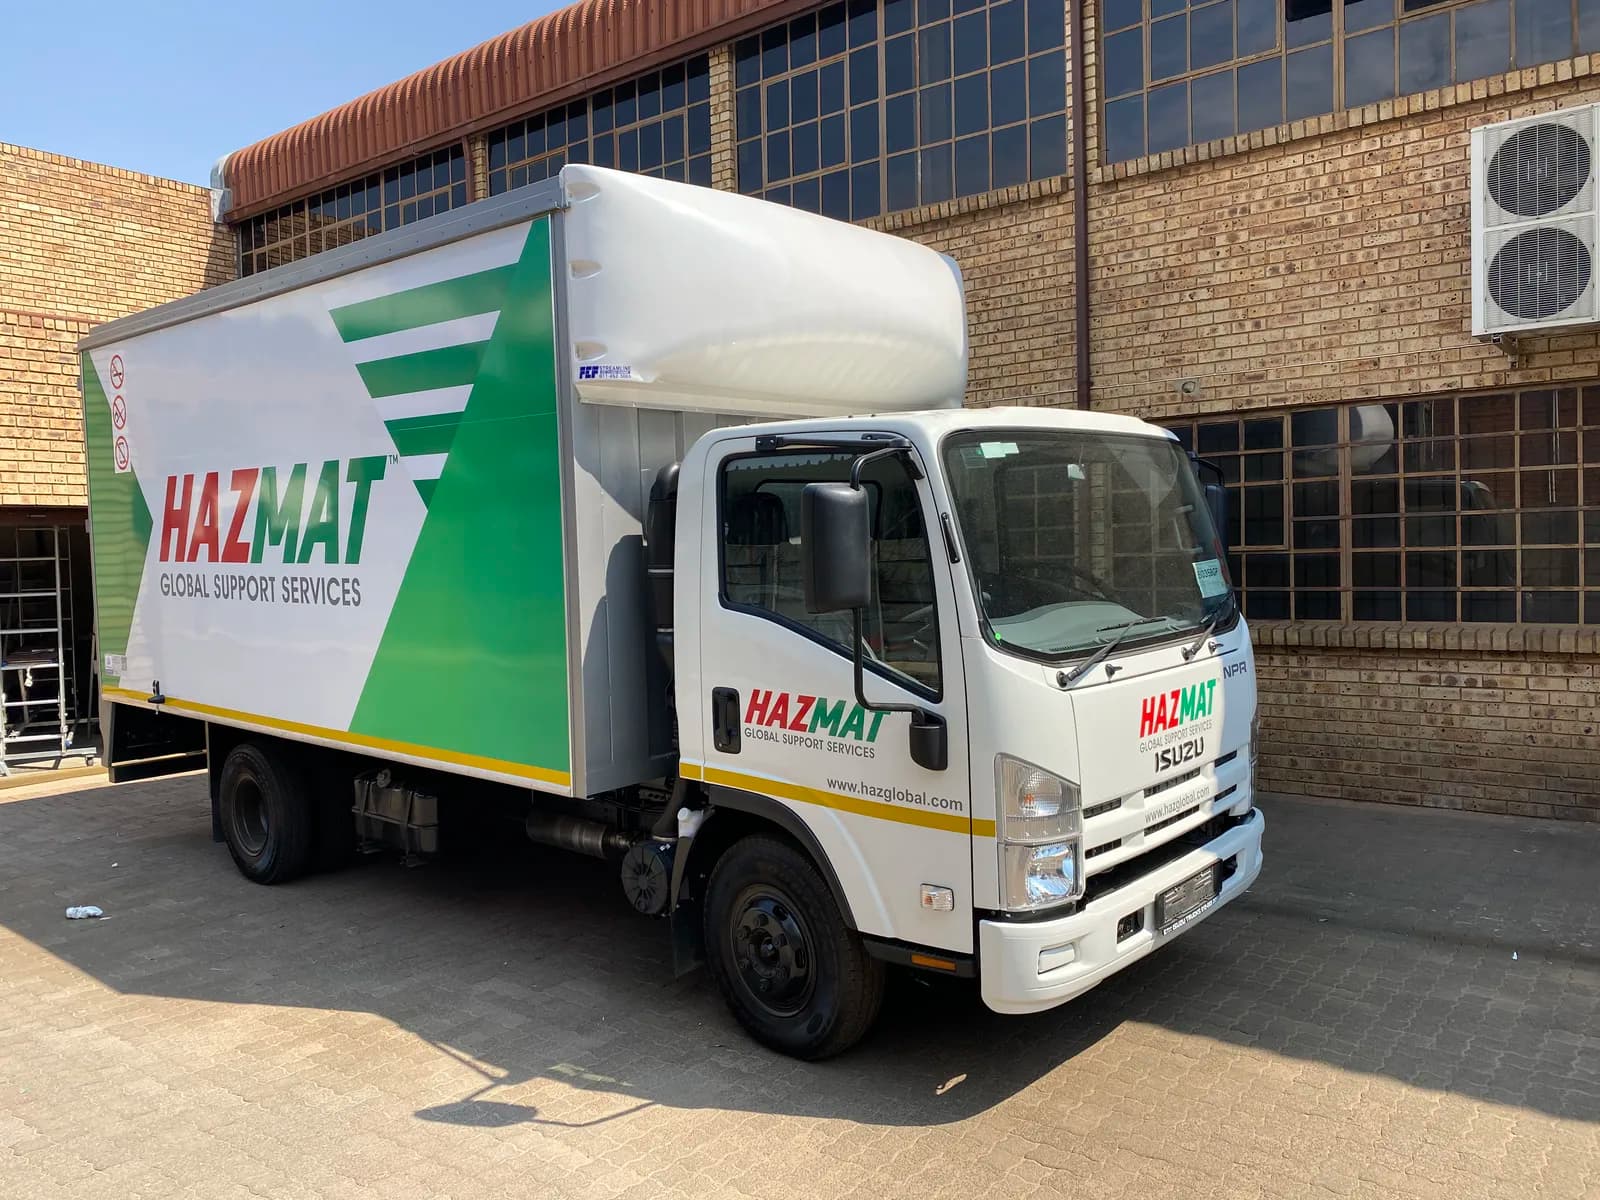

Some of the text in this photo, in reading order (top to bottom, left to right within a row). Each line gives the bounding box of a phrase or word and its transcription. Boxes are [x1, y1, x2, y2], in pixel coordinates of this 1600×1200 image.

[159, 455, 388, 564] HAZMAT
[160, 573, 361, 607] GLOBAL SUPPORT SERVICES
[1223, 661, 1247, 679] NPR
[744, 689, 891, 743] HAZMAT
[1140, 679, 1216, 738] HAZMAT
[744, 727, 875, 759] GLOBAL SUPPORT SERVICES
[1140, 719, 1212, 753] GLOBAL SUPPORT SERVICES
[1155, 736, 1204, 773] ISUZU
[827, 778, 963, 811] www.hazglobal.com
[1145, 786, 1210, 823] www.hazglobal.com
